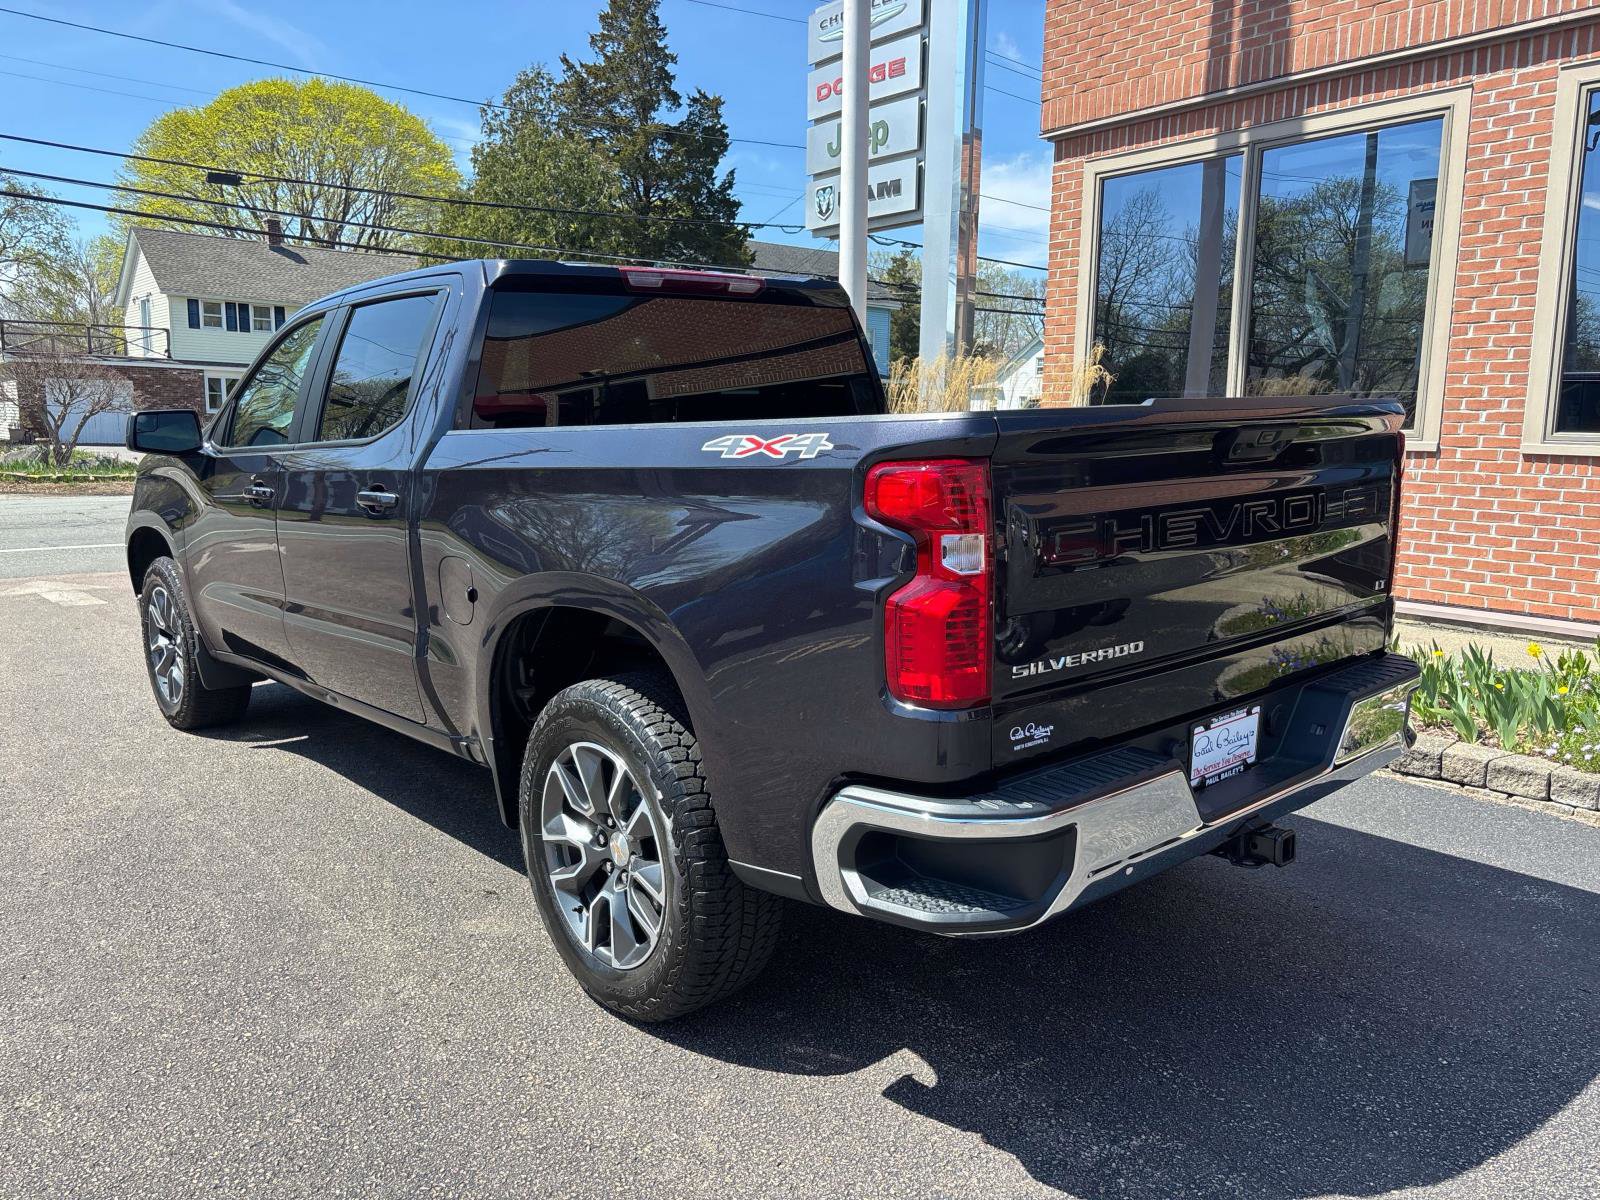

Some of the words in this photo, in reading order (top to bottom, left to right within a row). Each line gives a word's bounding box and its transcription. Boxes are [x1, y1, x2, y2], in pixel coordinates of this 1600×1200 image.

[816, 57, 906, 102] DOGE
[826, 119, 889, 157] Jp
[1012, 641, 1144, 679] SILVERADO
[1194, 735, 1214, 757] Paul
[1193, 768, 1203, 777] The
[1206, 776, 1220, 786] PAUL
